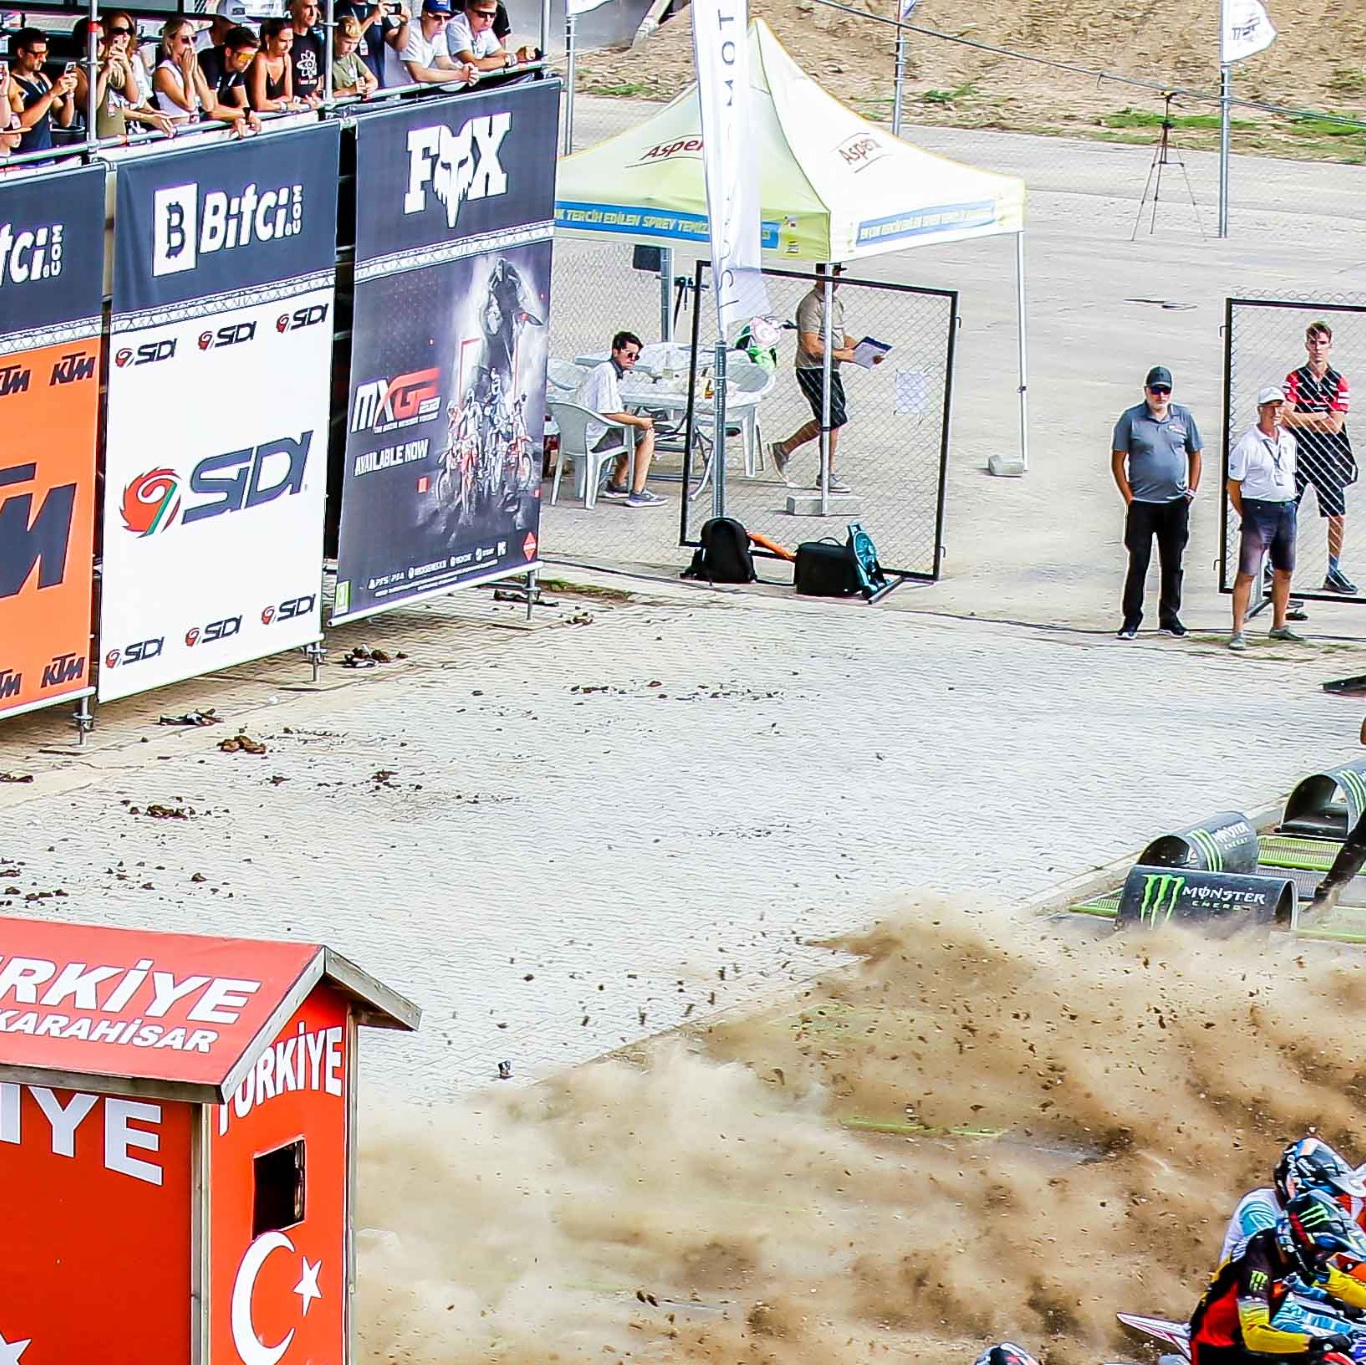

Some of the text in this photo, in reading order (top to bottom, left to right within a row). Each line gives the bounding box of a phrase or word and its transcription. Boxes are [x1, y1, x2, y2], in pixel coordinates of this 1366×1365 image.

[641, 138, 704, 161] Aspe
[199, 183, 288, 254] Bitci
[49, 352, 96, 386] KTM
[354, 439, 429, 477] AVAILABLE NOW
[41, 652, 85, 688] KTM
[1183, 885, 1266, 905] MONSTER
